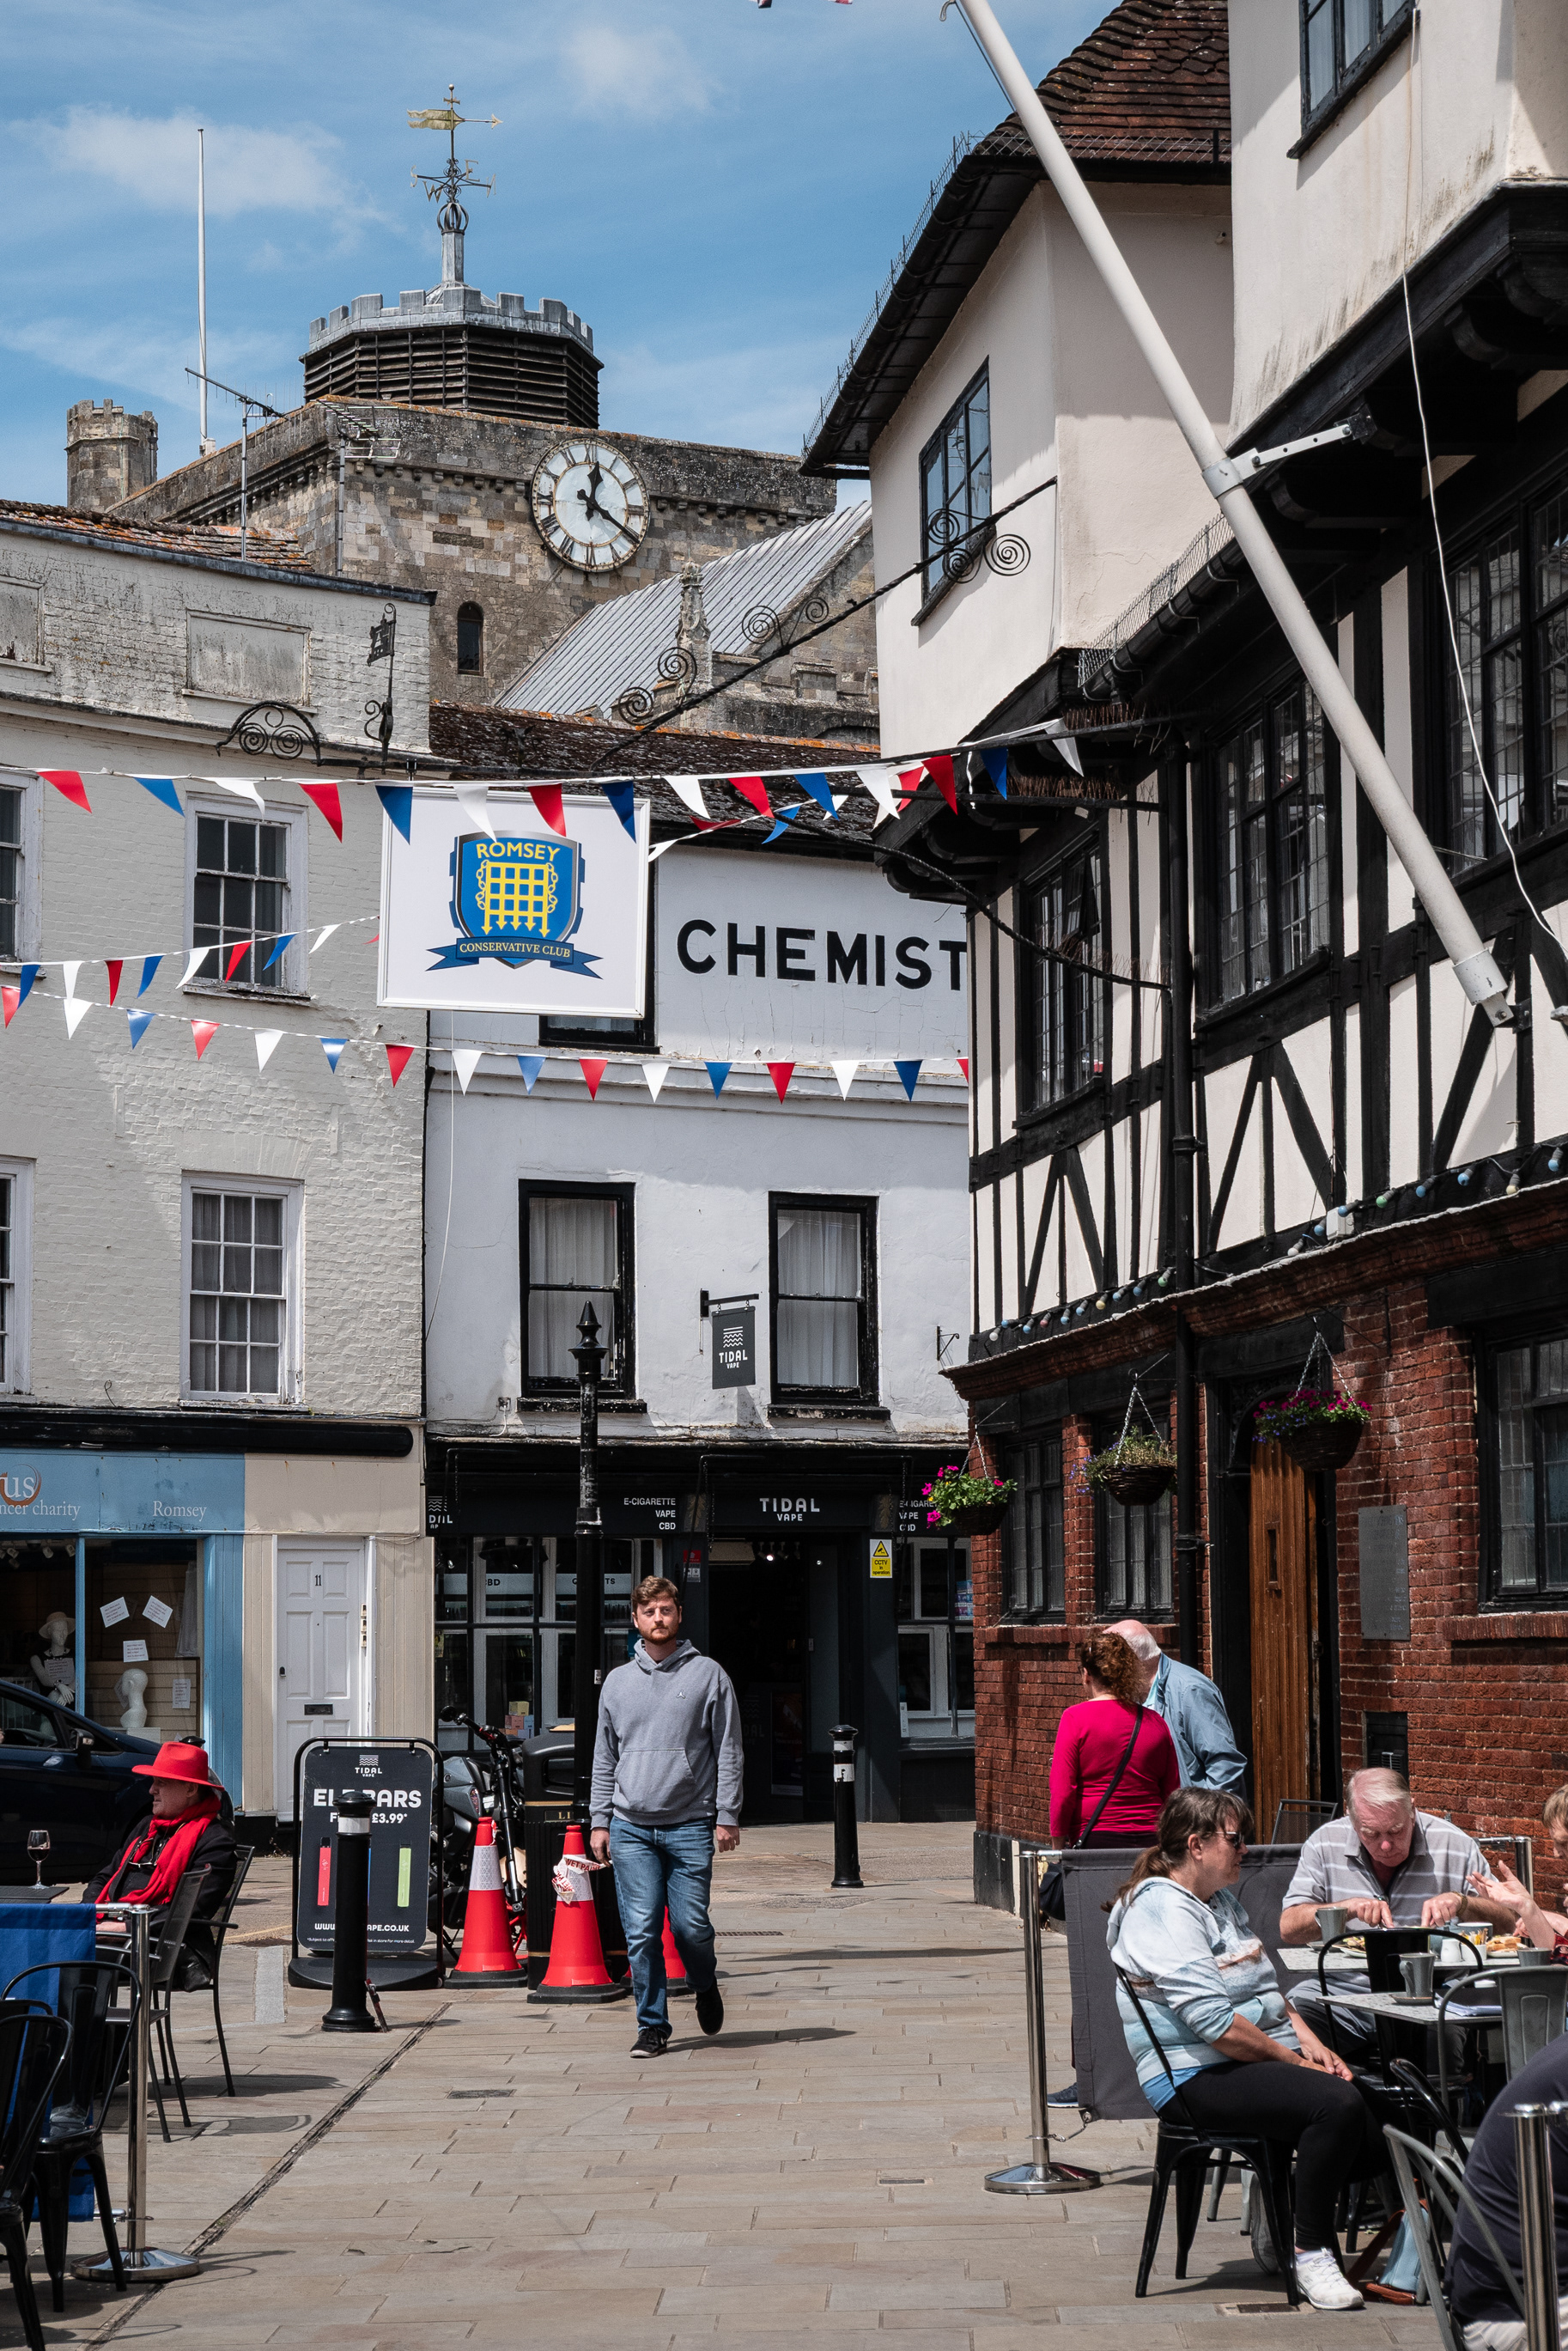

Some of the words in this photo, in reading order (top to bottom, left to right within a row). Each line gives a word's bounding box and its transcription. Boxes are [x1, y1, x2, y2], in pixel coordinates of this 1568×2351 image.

[476, 842, 561, 862] ROMSEY
[459, 942, 540, 953] CONSERVATIVE
[542, 946, 570, 958] CLUB
[677, 919, 967, 991] CHEMIST
[719, 1349, 748, 1364] TIDAL
[623, 1497, 676, 1506] E-CIGARETTE
[760, 1498, 820, 1512] TIDAL
[33, 1499, 81, 1521] charity
[153, 1501, 207, 1521] Romsey
[659, 1522, 676, 1531] CBD
[314, 1574, 322, 1587] 11
[485, 1578, 501, 1587] BD
